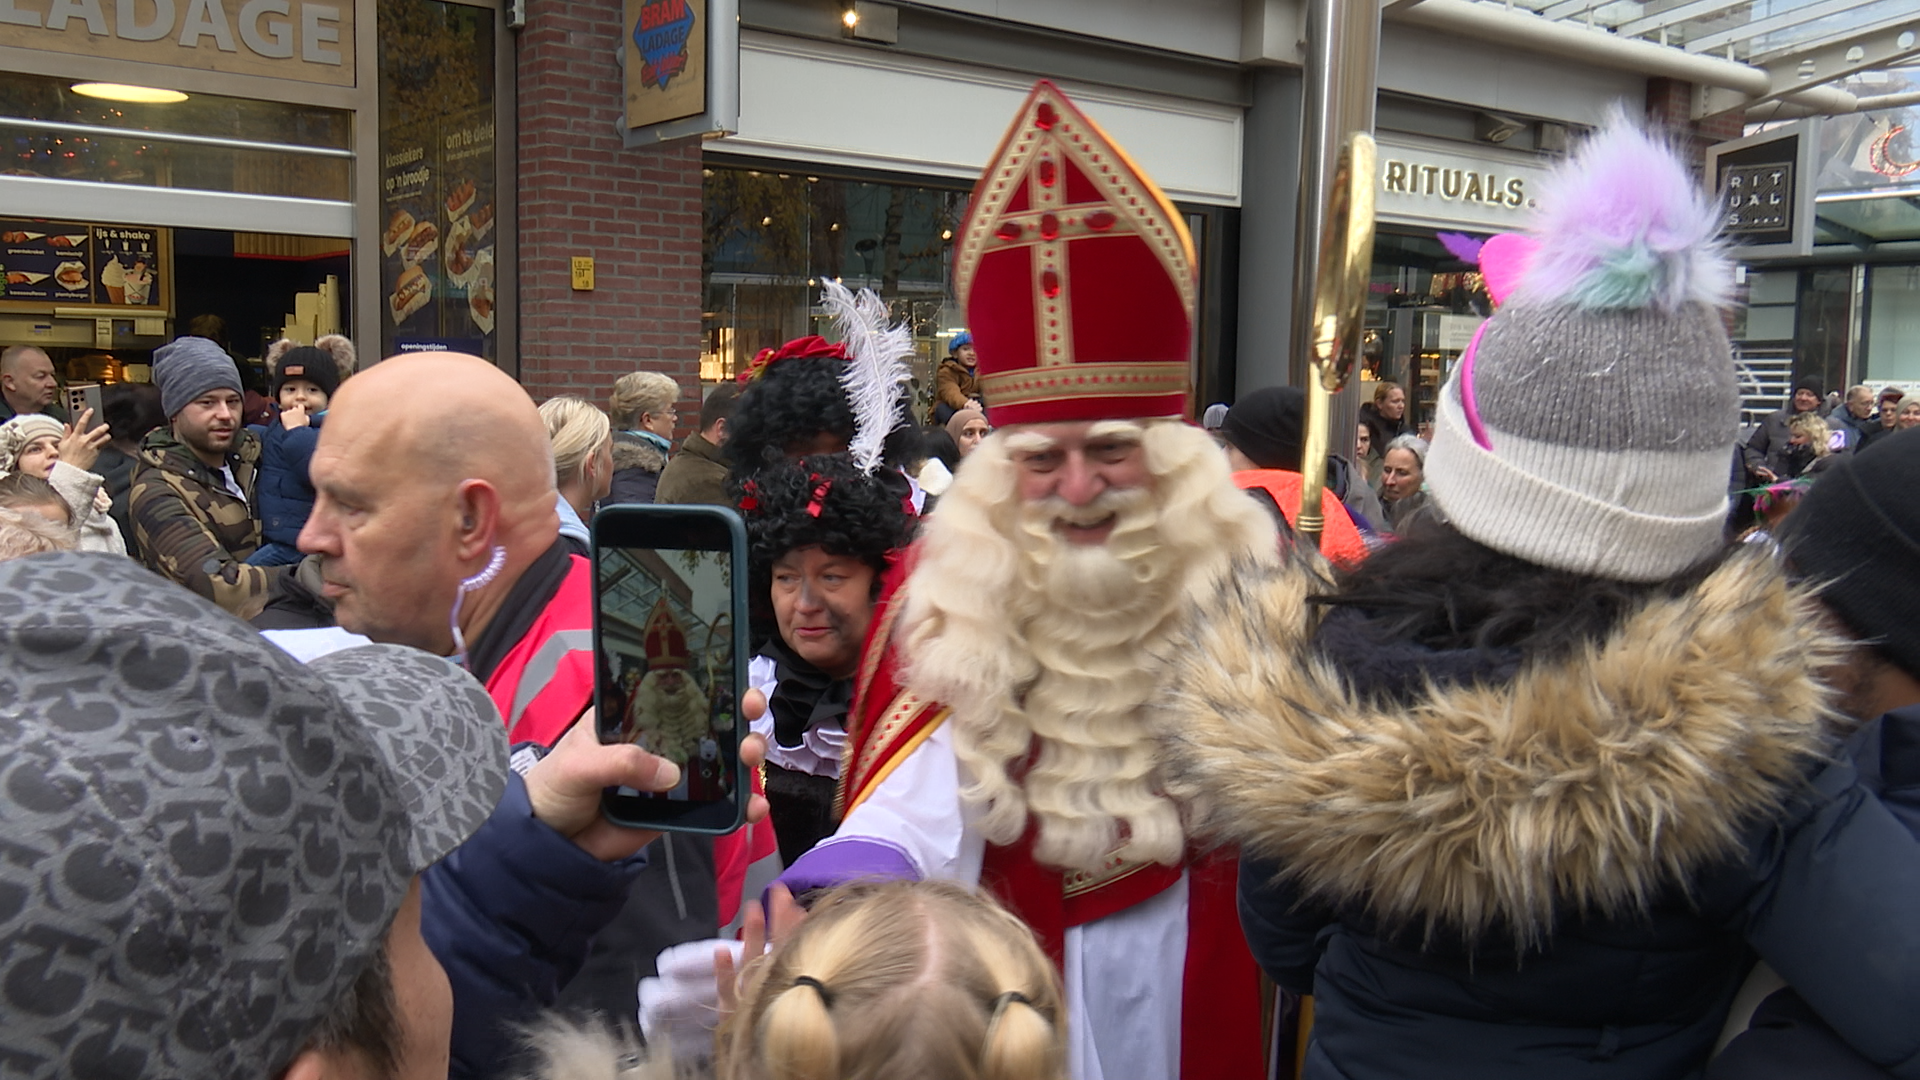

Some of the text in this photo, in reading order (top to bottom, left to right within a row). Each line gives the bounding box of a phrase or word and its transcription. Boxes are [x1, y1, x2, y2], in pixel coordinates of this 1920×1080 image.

[641, 0, 686, 31] BRAM
[642, 26, 685, 54] LADAGE
[386, 147, 423, 168] klassiekers
[386, 177, 395, 194] op
[402, 165, 429, 187] broodje
[1731, 172, 1781, 188] RIT
[1730, 193, 1780, 207] UAL
[119, 230, 150, 240] shake
[400, 343, 447, 351] openingstijden
